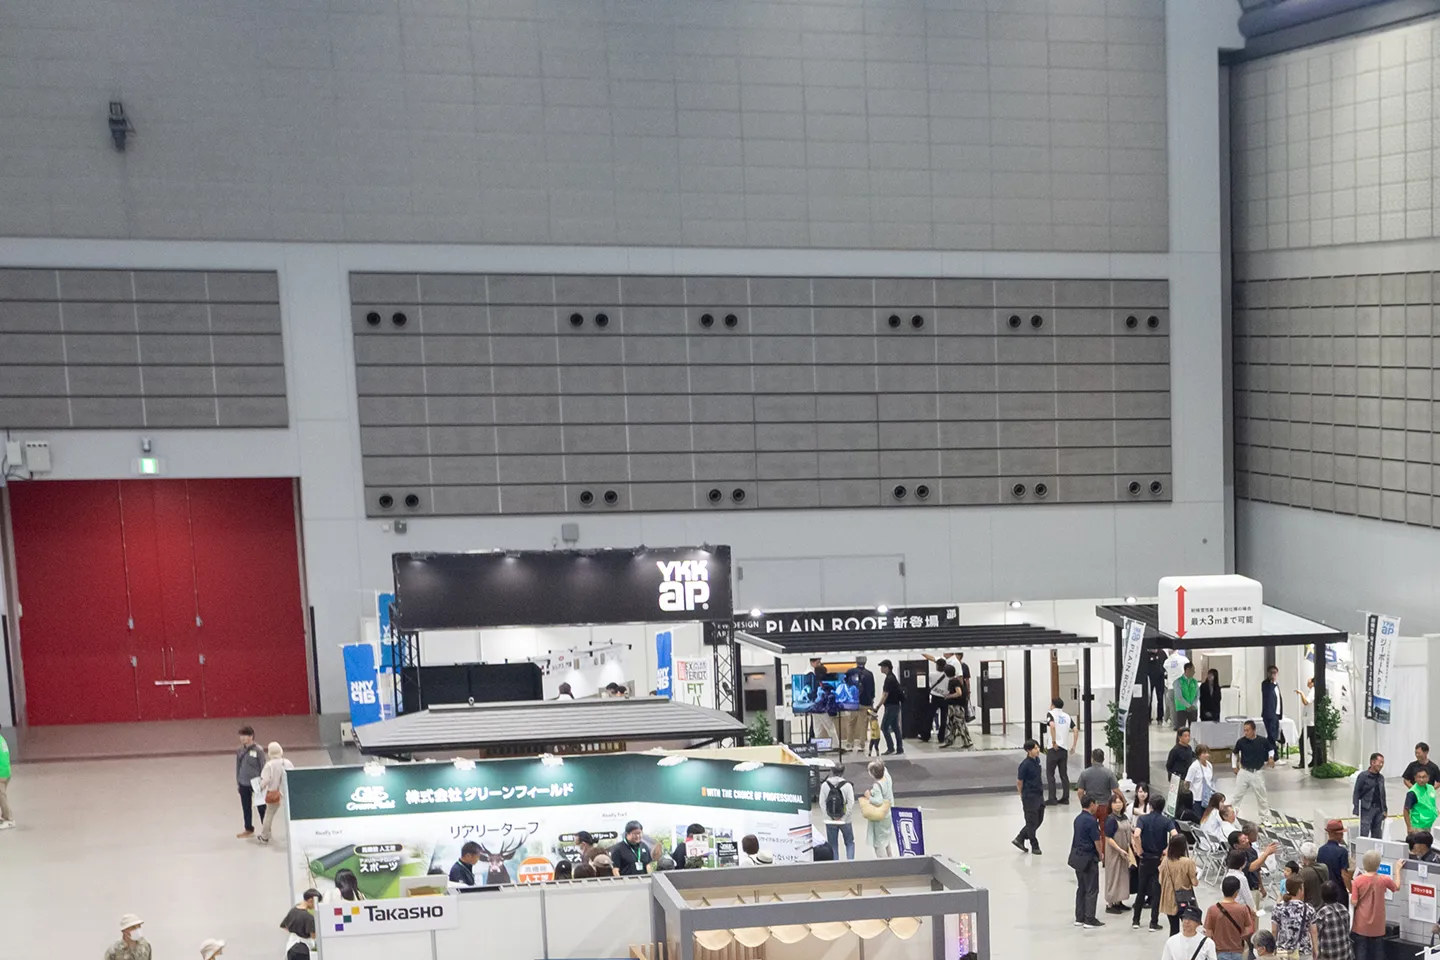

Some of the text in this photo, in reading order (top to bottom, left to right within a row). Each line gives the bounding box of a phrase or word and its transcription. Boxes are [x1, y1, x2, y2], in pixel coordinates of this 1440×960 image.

[656, 560, 708, 581] YKK
[658, 581, 710, 611] ap
[766, 615, 940, 632] PLAIN ROOF 新登場
[1190, 614, 1254, 626] 最大3mまで可能
[464, 783, 574, 802] グリーンフィールド
[706, 788, 804, 804] WITH THE CHOICE OF PROFESSIONAL
[450, 821, 539, 839] リアリーターフ
[360, 862, 398, 873] スポーツ
